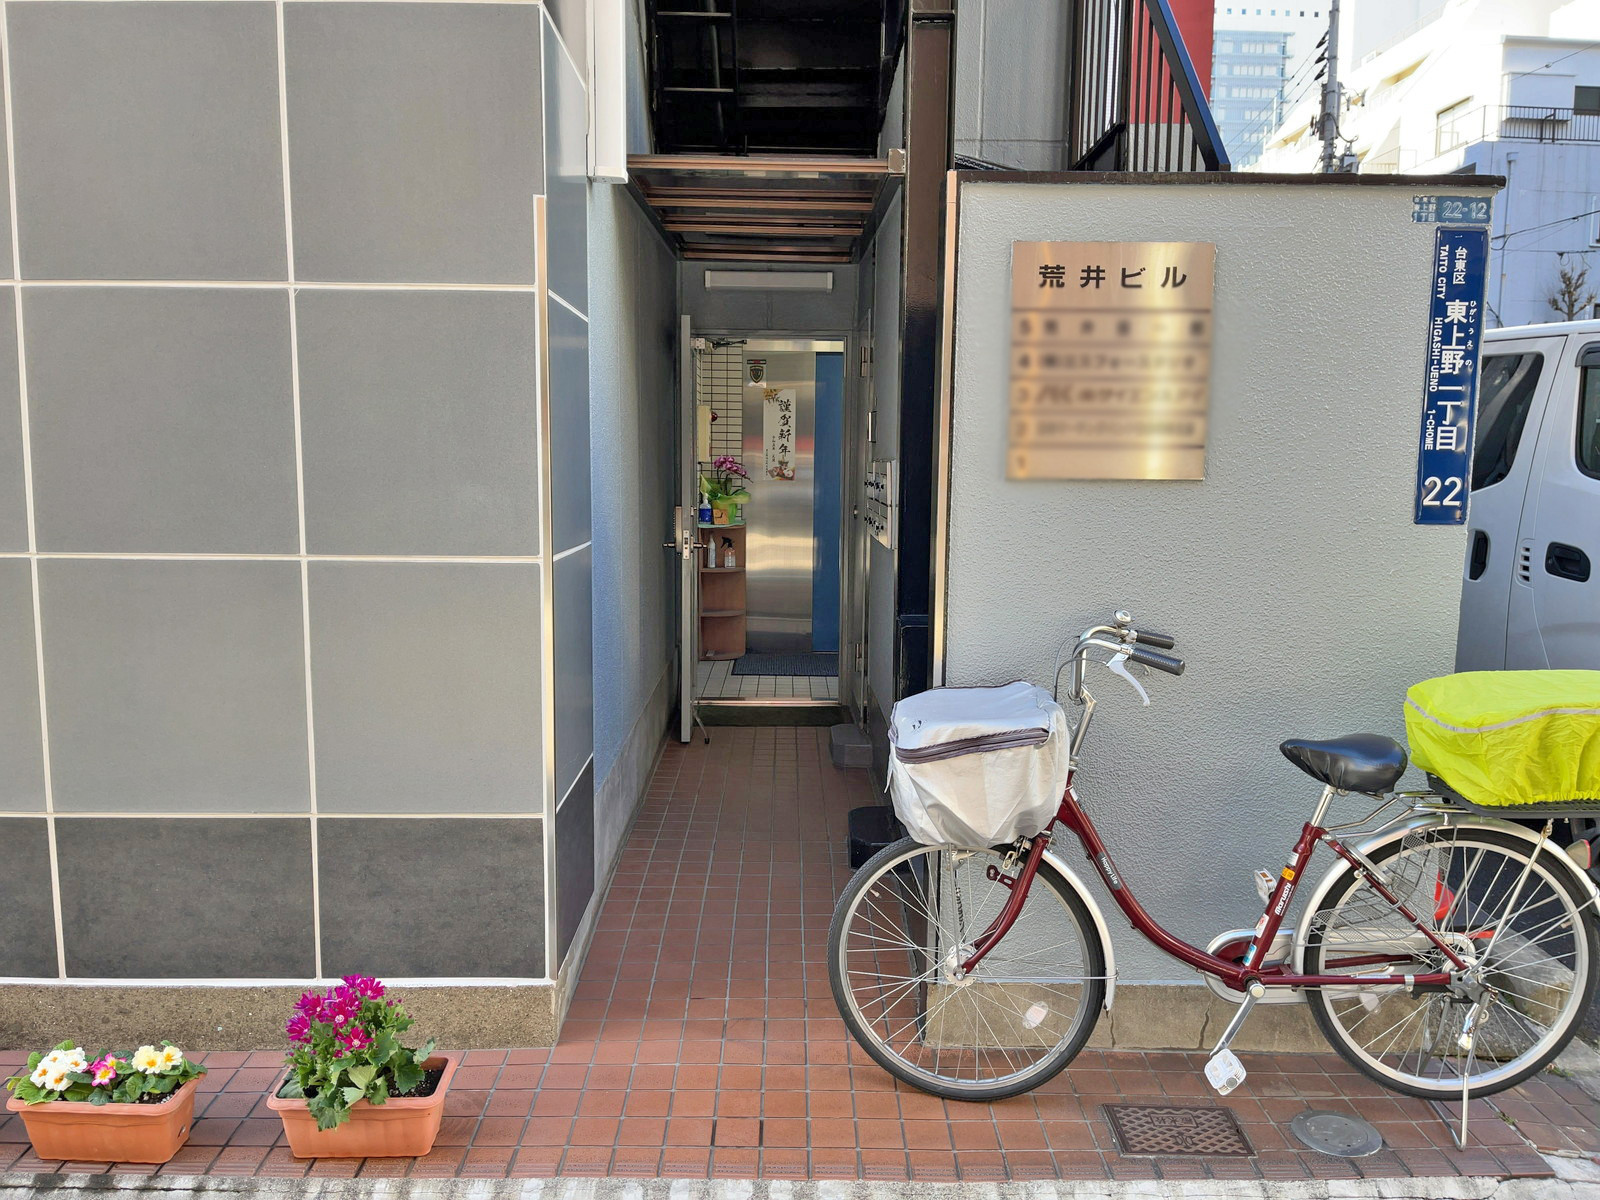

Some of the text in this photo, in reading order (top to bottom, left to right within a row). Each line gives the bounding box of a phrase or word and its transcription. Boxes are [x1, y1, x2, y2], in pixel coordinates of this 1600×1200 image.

[1442, 201, 1487, 219] 22-12
[1038, 264, 1188, 289] 荒井ビル
[1436, 244, 1449, 299] TAITO CITY
[1452, 245, 1468, 285] 台東区
[1429, 317, 1444, 392] HIGASHI-UENO
[1436, 298, 1469, 451] 東上野一丁目
[1424, 409, 1436, 451] 1-CHOME
[1422, 476, 1463, 506] 22
[1101, 856, 1113, 875] Happy
